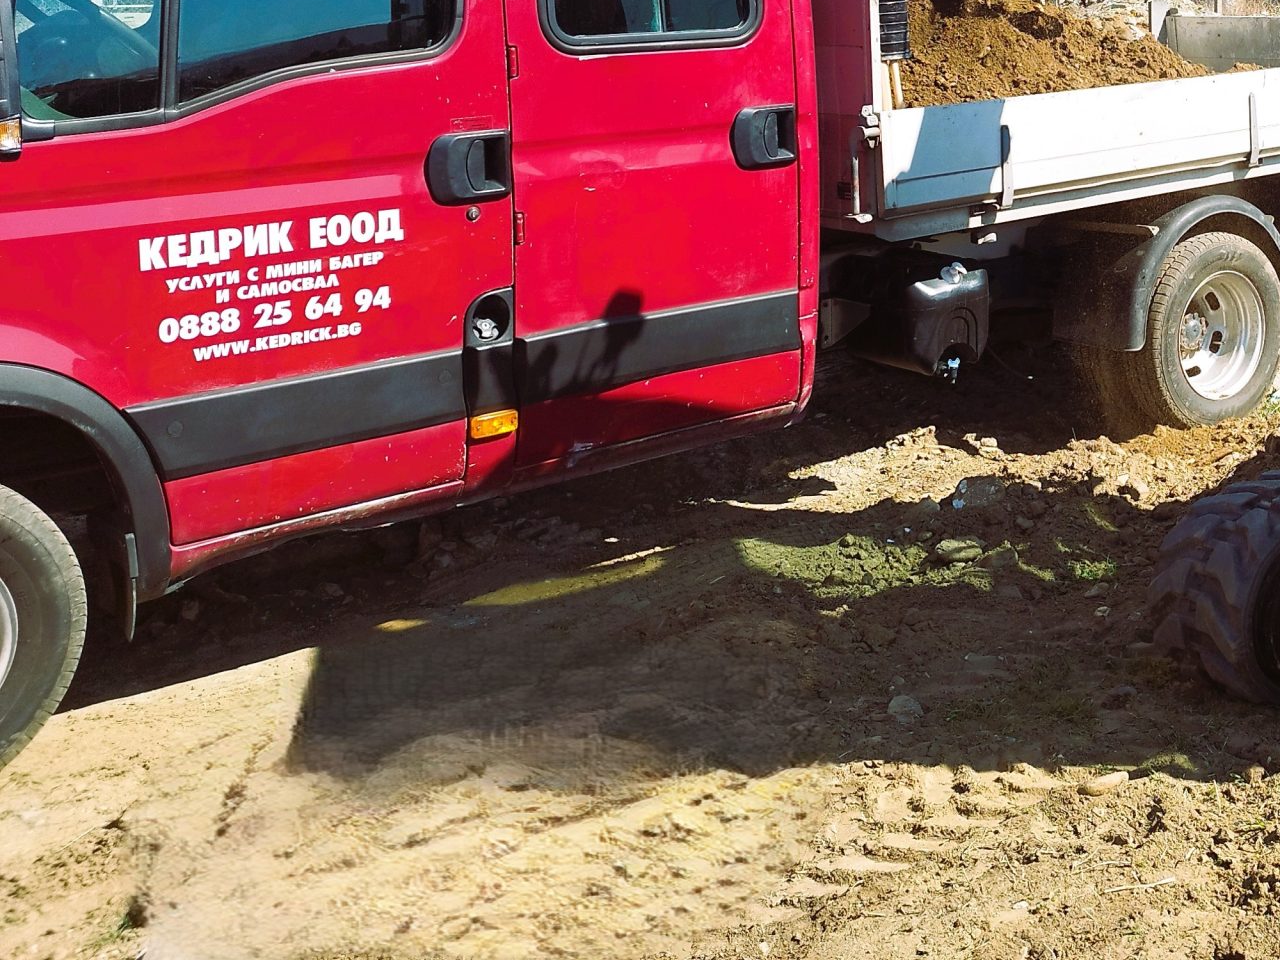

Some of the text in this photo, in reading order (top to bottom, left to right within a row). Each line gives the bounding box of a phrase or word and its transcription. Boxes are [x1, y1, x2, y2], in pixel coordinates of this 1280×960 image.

[138, 208, 404, 272] КЕДРИК ЕООД
[165, 251, 384, 293] УСЛУГИ С МИНИ БАГЕР
[215, 274, 339, 304] И САМОСВАЛ
[158, 286, 391, 343] 0888 25 64 94
[193, 322, 362, 362] WWW.KEDRICK.BG
